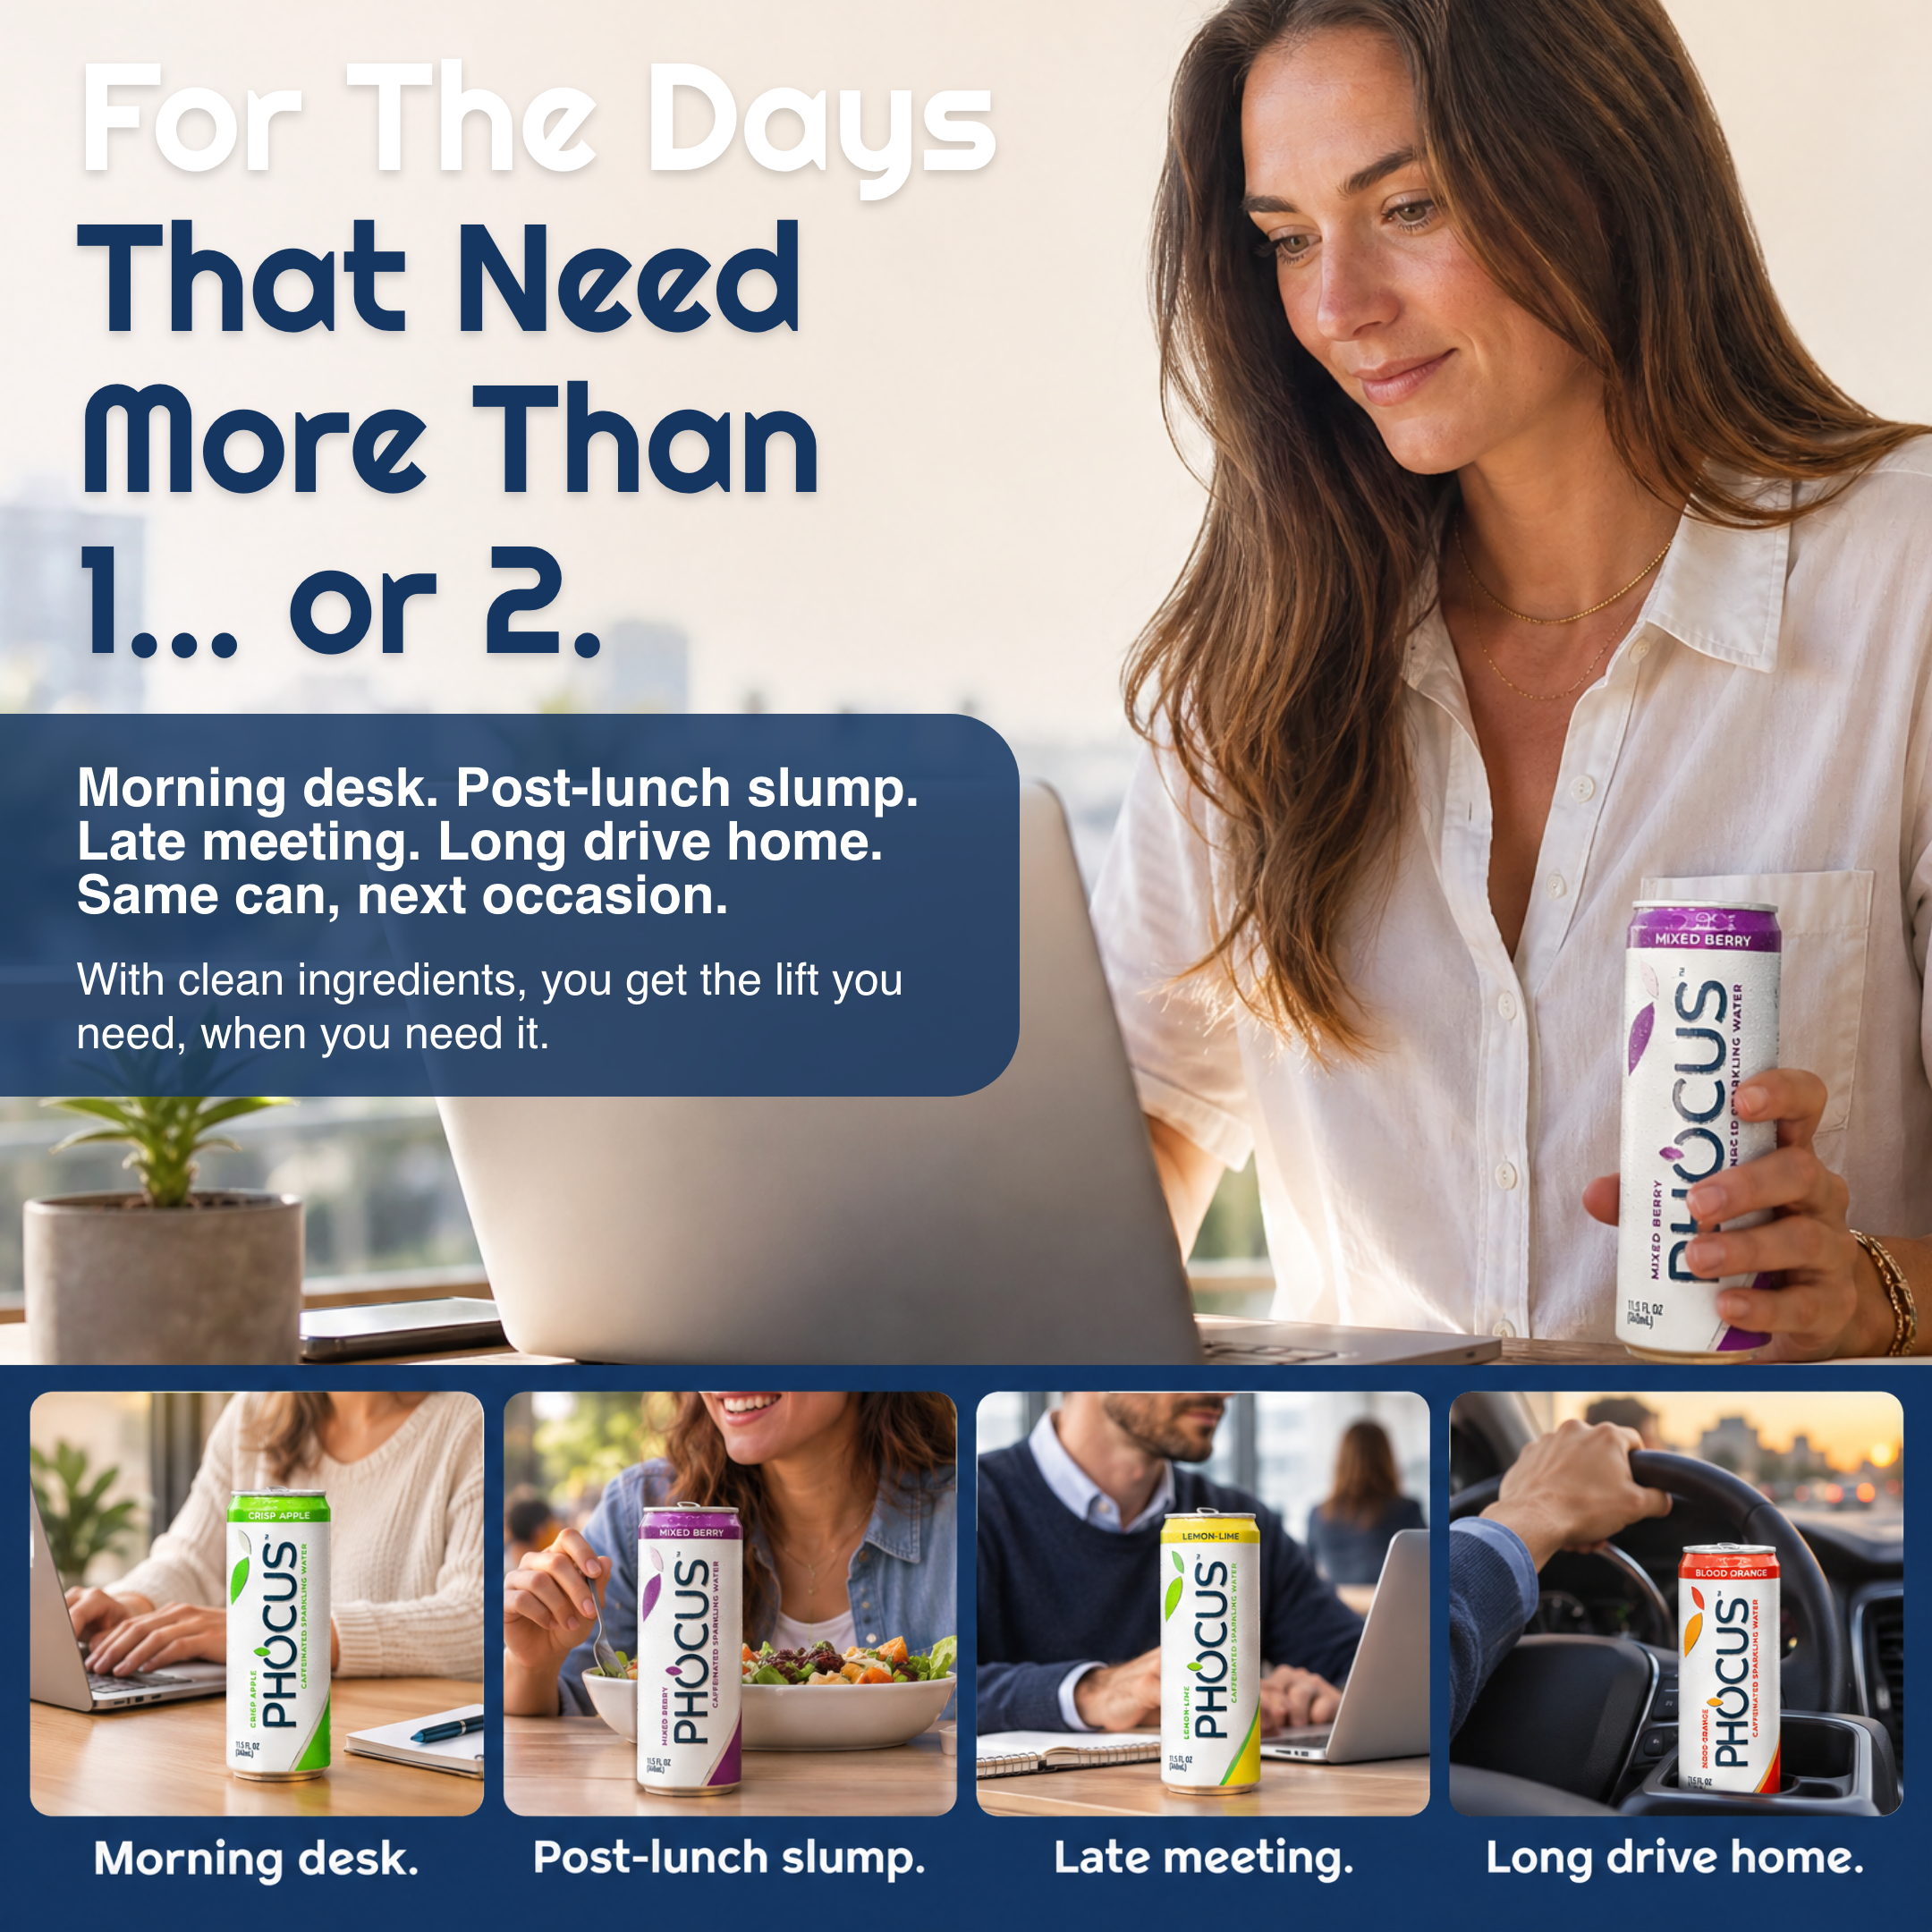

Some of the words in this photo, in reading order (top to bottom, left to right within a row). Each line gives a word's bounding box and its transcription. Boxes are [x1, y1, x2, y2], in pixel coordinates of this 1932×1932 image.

[1655, 933, 1700, 945] MIXED
[1705, 934, 1751, 946] BERRY
[1733, 984, 1742, 1032] WATER
[1653, 1180, 1663, 1228] BERRY
[1651, 1232, 1661, 1280] MIXED
[249, 1512, 275, 1520] CRISP
[279, 1512, 309, 1520] APPLE
[659, 1529, 690, 1537] MIXED
[693, 1529, 724, 1537] BERRY
[1182, 1532, 1239, 1540] LEMON-LIME
[1696, 1569, 1727, 1577] BLOOD
[1730, 1569, 1767, 1578] ORANGE
[262, 1541, 297, 1728] PHOCUS
[674, 1559, 709, 1744] PHOCUS
[1195, 1561, 1227, 1738] PHOCUS
[1715, 1598, 1749, 1767] PHOCUS
